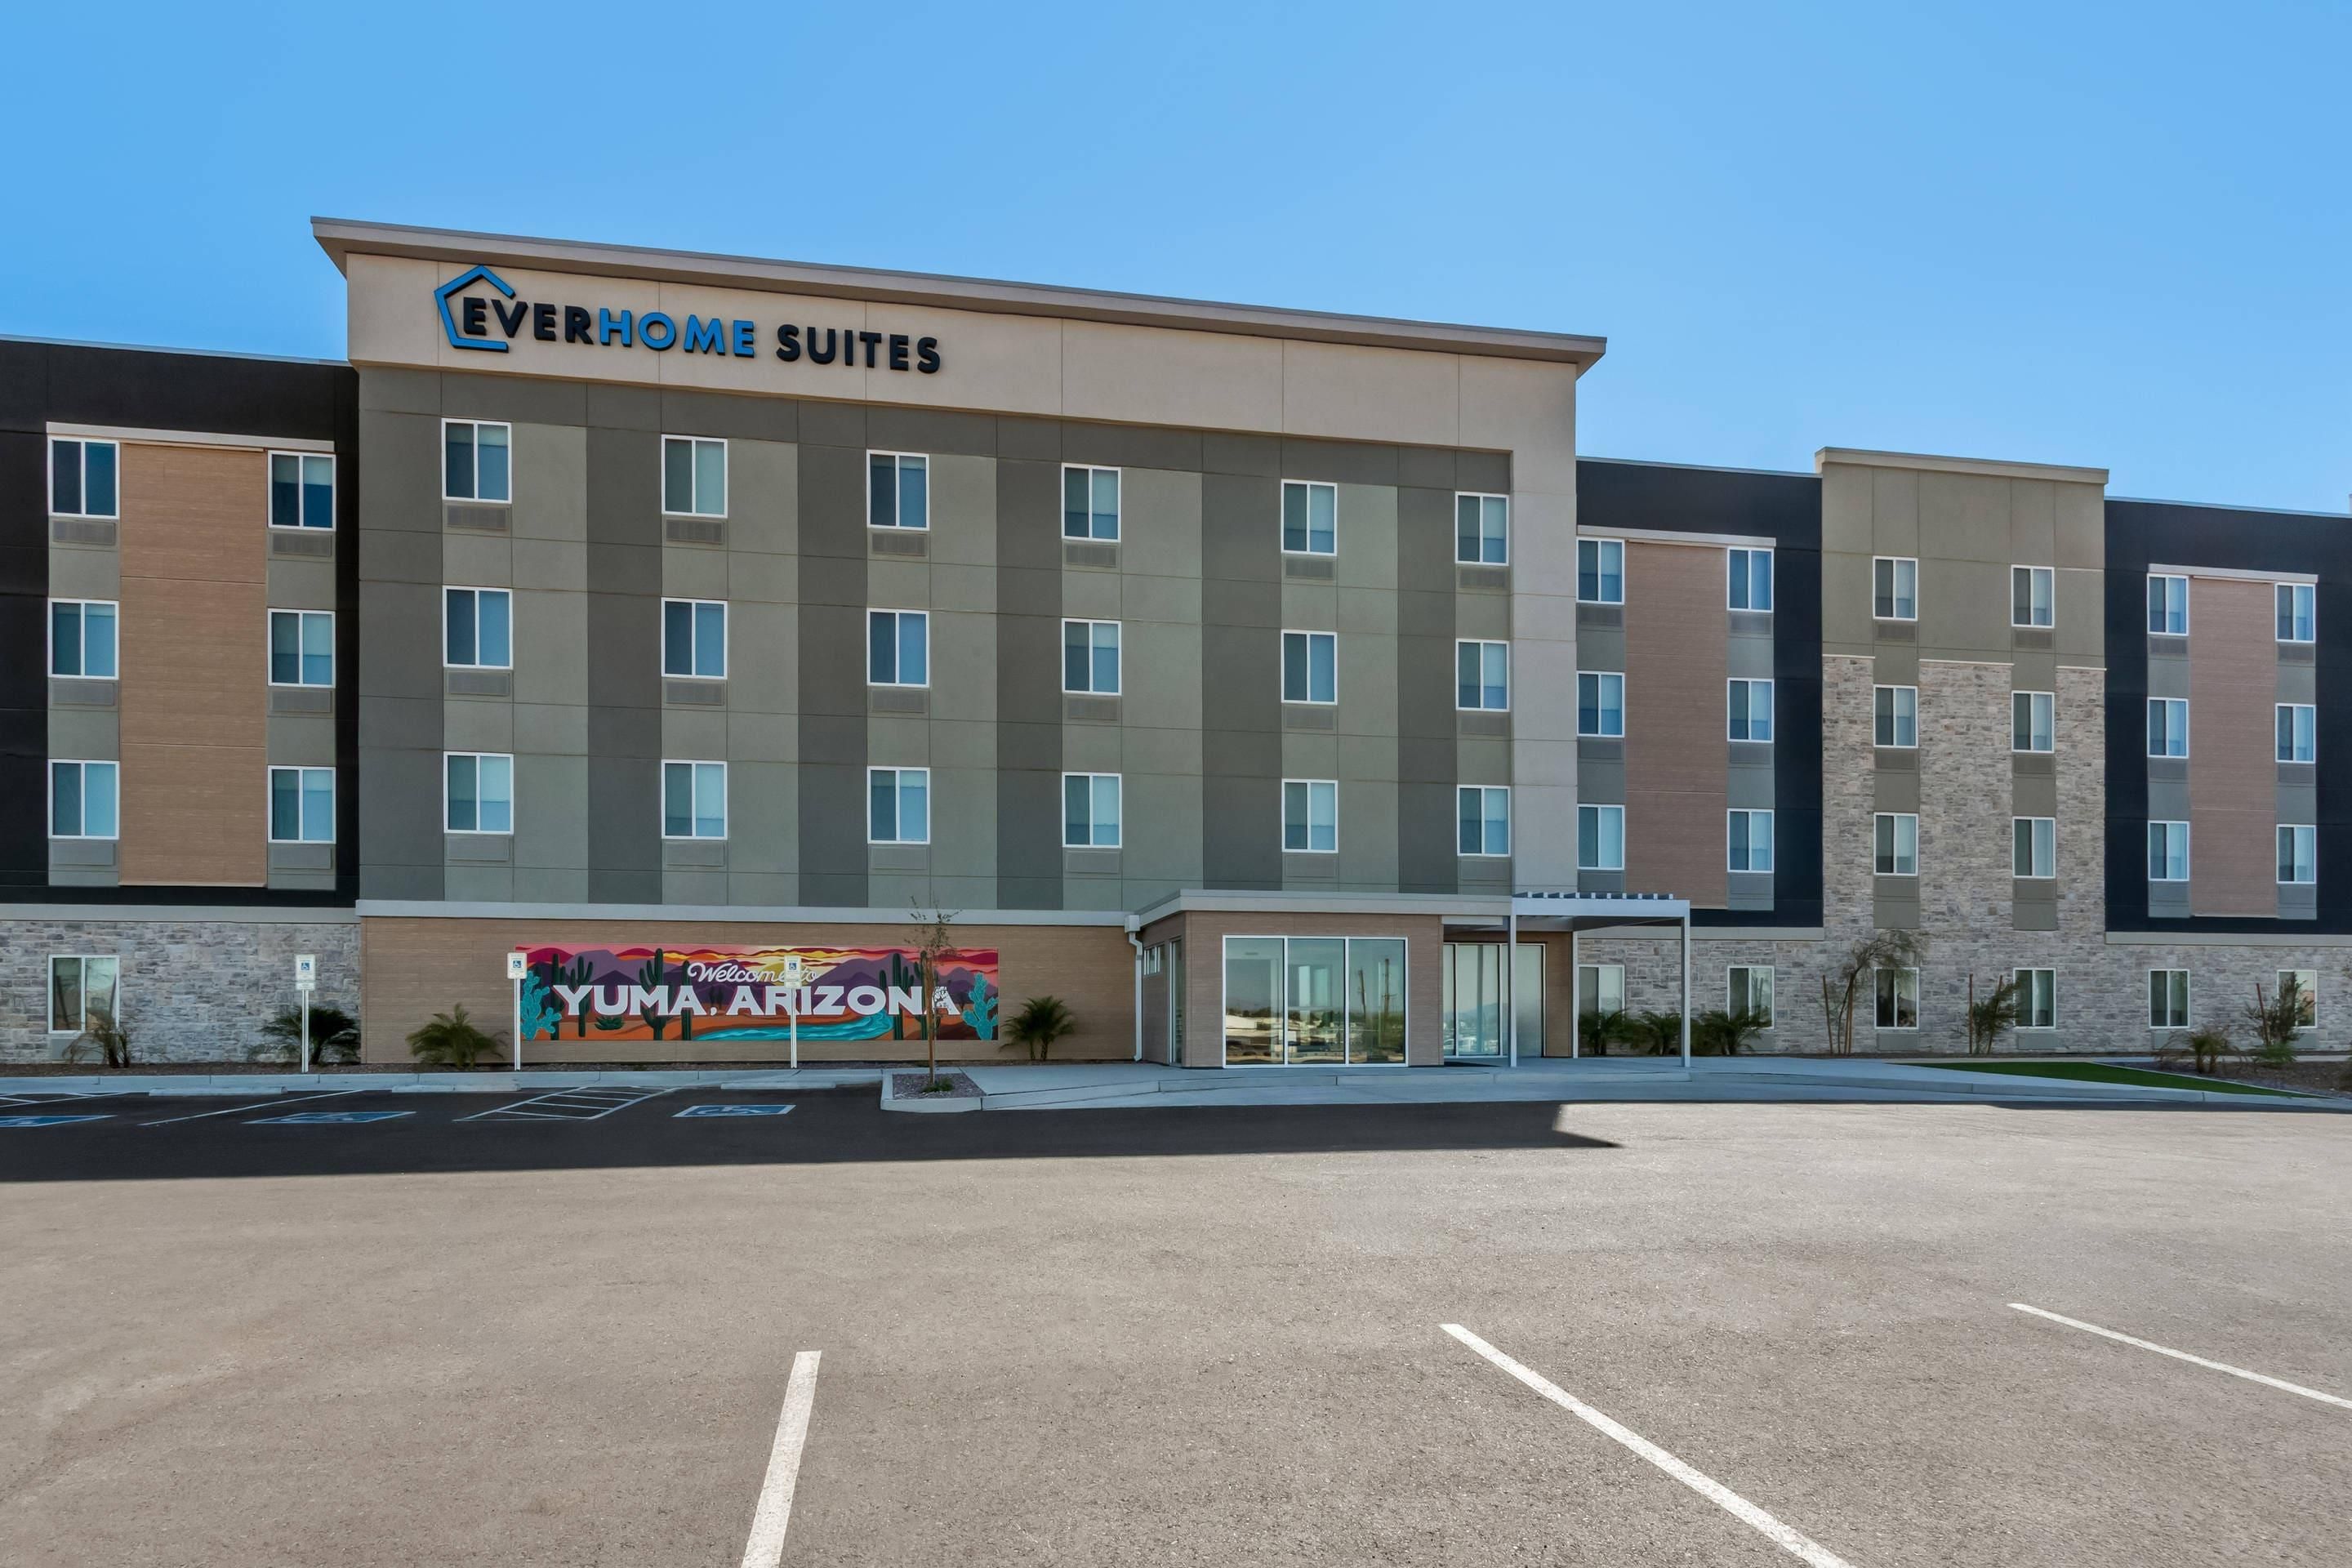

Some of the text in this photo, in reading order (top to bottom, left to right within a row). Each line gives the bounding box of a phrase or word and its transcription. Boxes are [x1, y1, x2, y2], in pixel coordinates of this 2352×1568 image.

[462, 296, 941, 374] EVERHOME SUITES
[800, 965, 823, 983] to
[552, 985, 961, 1016] YUMA, ARIZONA
